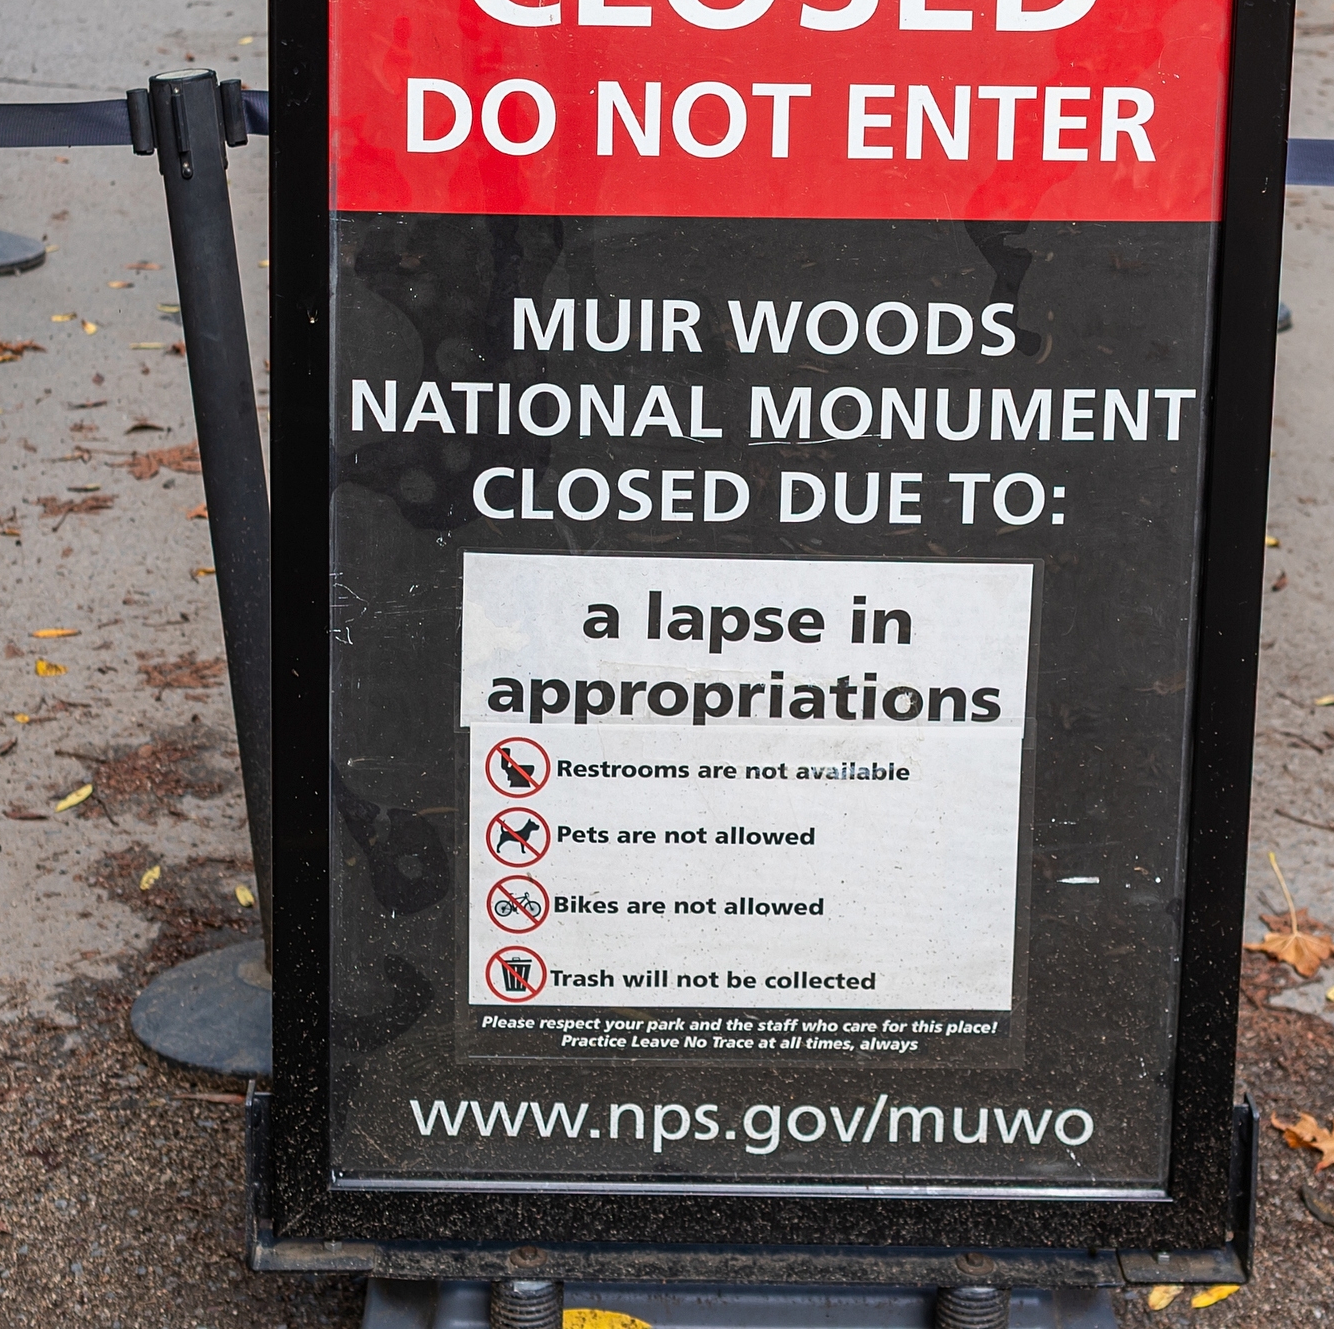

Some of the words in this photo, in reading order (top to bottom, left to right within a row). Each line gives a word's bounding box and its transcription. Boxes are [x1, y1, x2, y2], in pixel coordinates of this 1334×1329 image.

[407, 78, 556, 155] DO
[597, 81, 811, 158] NOT
[848, 84, 1155, 161] ENTER
[514, 298, 702, 352] MUIR
[728, 301, 1015, 356] WOODS
[352, 380, 722, 441] NATIONAL
[749, 387, 1196, 443] MONUMENT
[473, 467, 749, 521] CLOSED
[780, 472, 922, 523] DUE
[949, 473, 1065, 525] TO:
[583, 604, 619, 638] a
[648, 591, 824, 654] lapse
[852, 596, 911, 644] in
[488, 671, 1000, 725] appropriations
[557, 759, 690, 779] Restrooms
[697, 765, 737, 780] are
[745, 762, 789, 780] not
[795, 761, 910, 781] available
[557, 825, 610, 844] Pets
[616, 830, 657, 844] are
[664, 827, 708, 844] not
[714, 826, 815, 846] allowed
[554, 895, 619, 914] Bikes
[626, 900, 666, 915] are
[674, 897, 717, 915] not
[723, 896, 824, 917] allowed
[550, 970, 614, 987] Trash
[622, 969, 668, 988] will
[676, 971, 720, 989] not
[726, 970, 757, 989] be
[764, 971, 876, 990] collected
[481, 1015, 536, 1029] Please
[539, 1017, 602, 1033] respect
[603, 1020, 645, 1033] your
[645, 1017, 686, 1034] park
[689, 1017, 723, 1031] and
[725, 1018, 754, 1032] the
[757, 1018, 800, 1032] staff
[801, 1018, 839, 1033] who
[842, 1022, 878, 1033] care
[881, 1019, 908, 1033] for
[911, 1019, 944, 1034] this
[945, 1020, 999, 1037] place!
[561, 1034, 627, 1048] Practice
[631, 1035, 680, 1048] Leave
[683, 1035, 708, 1049] No
[712, 1035, 755, 1049] Trace
[757, 1037, 777, 1049] at
[779, 1036, 802, 1049] all
[805, 1036, 855, 1052] times,
[859, 1036, 919, 1054] always
[409, 1093, 1094, 1155] www.nps.gov/muwo
